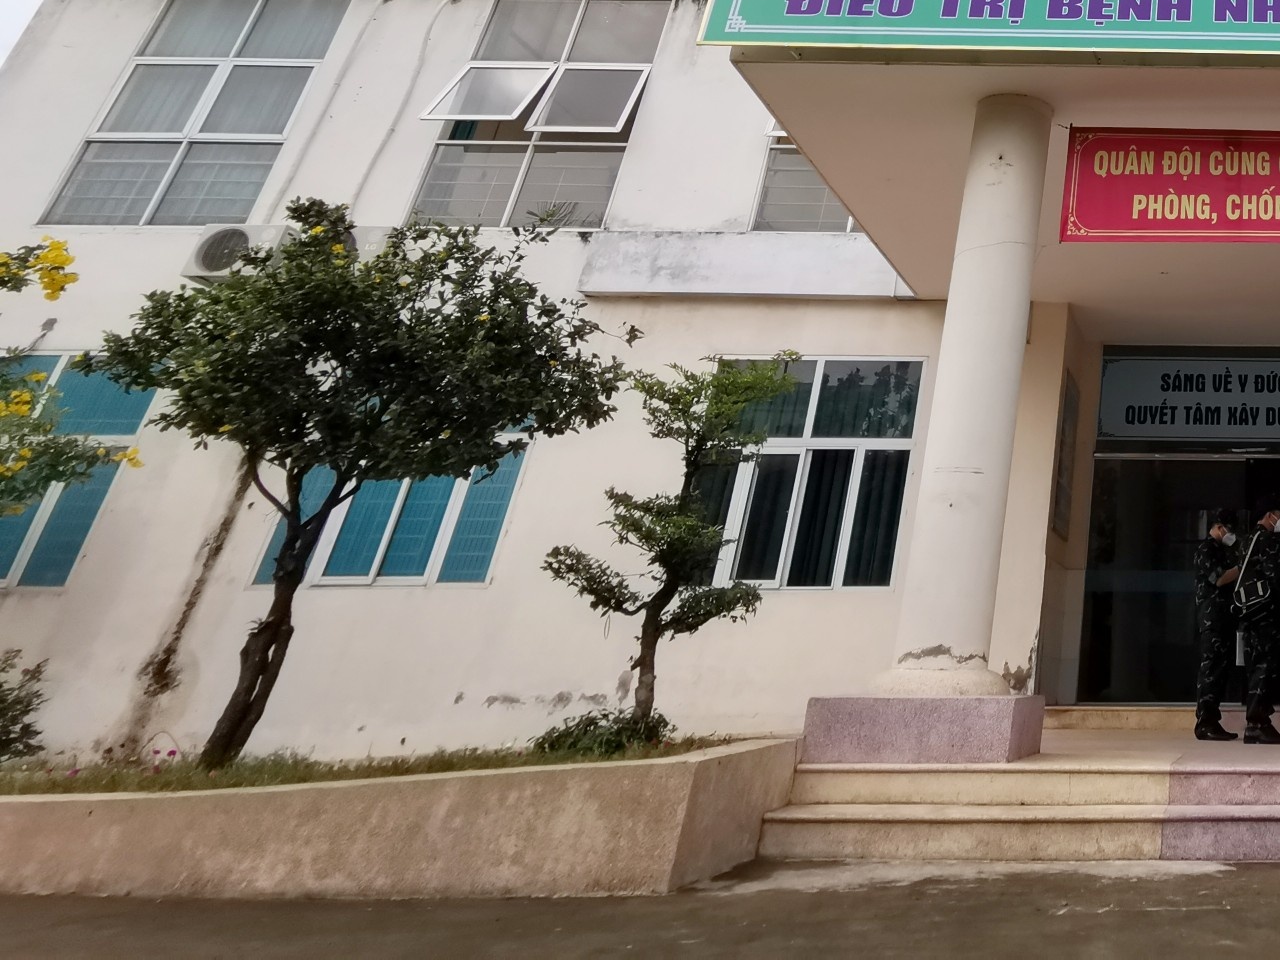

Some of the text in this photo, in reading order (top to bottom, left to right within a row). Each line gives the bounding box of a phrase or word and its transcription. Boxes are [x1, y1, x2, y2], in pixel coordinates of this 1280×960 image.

[1093, 145, 1155, 178] QUÂN
[1162, 146, 1201, 181] ĐỘI
[1209, 146, 1271, 176] CÙNG
[1132, 189, 1217, 224] PHÒNG,
[1160, 370, 1206, 393] SÁNG
[1212, 367, 1232, 393] VỀ
[1238, 374, 1249, 393] Y
[1125, 398, 1178, 426] QUYẾT
[1184, 402, 1221, 426] TÂM
[1227, 402, 1260, 426] XÂY
